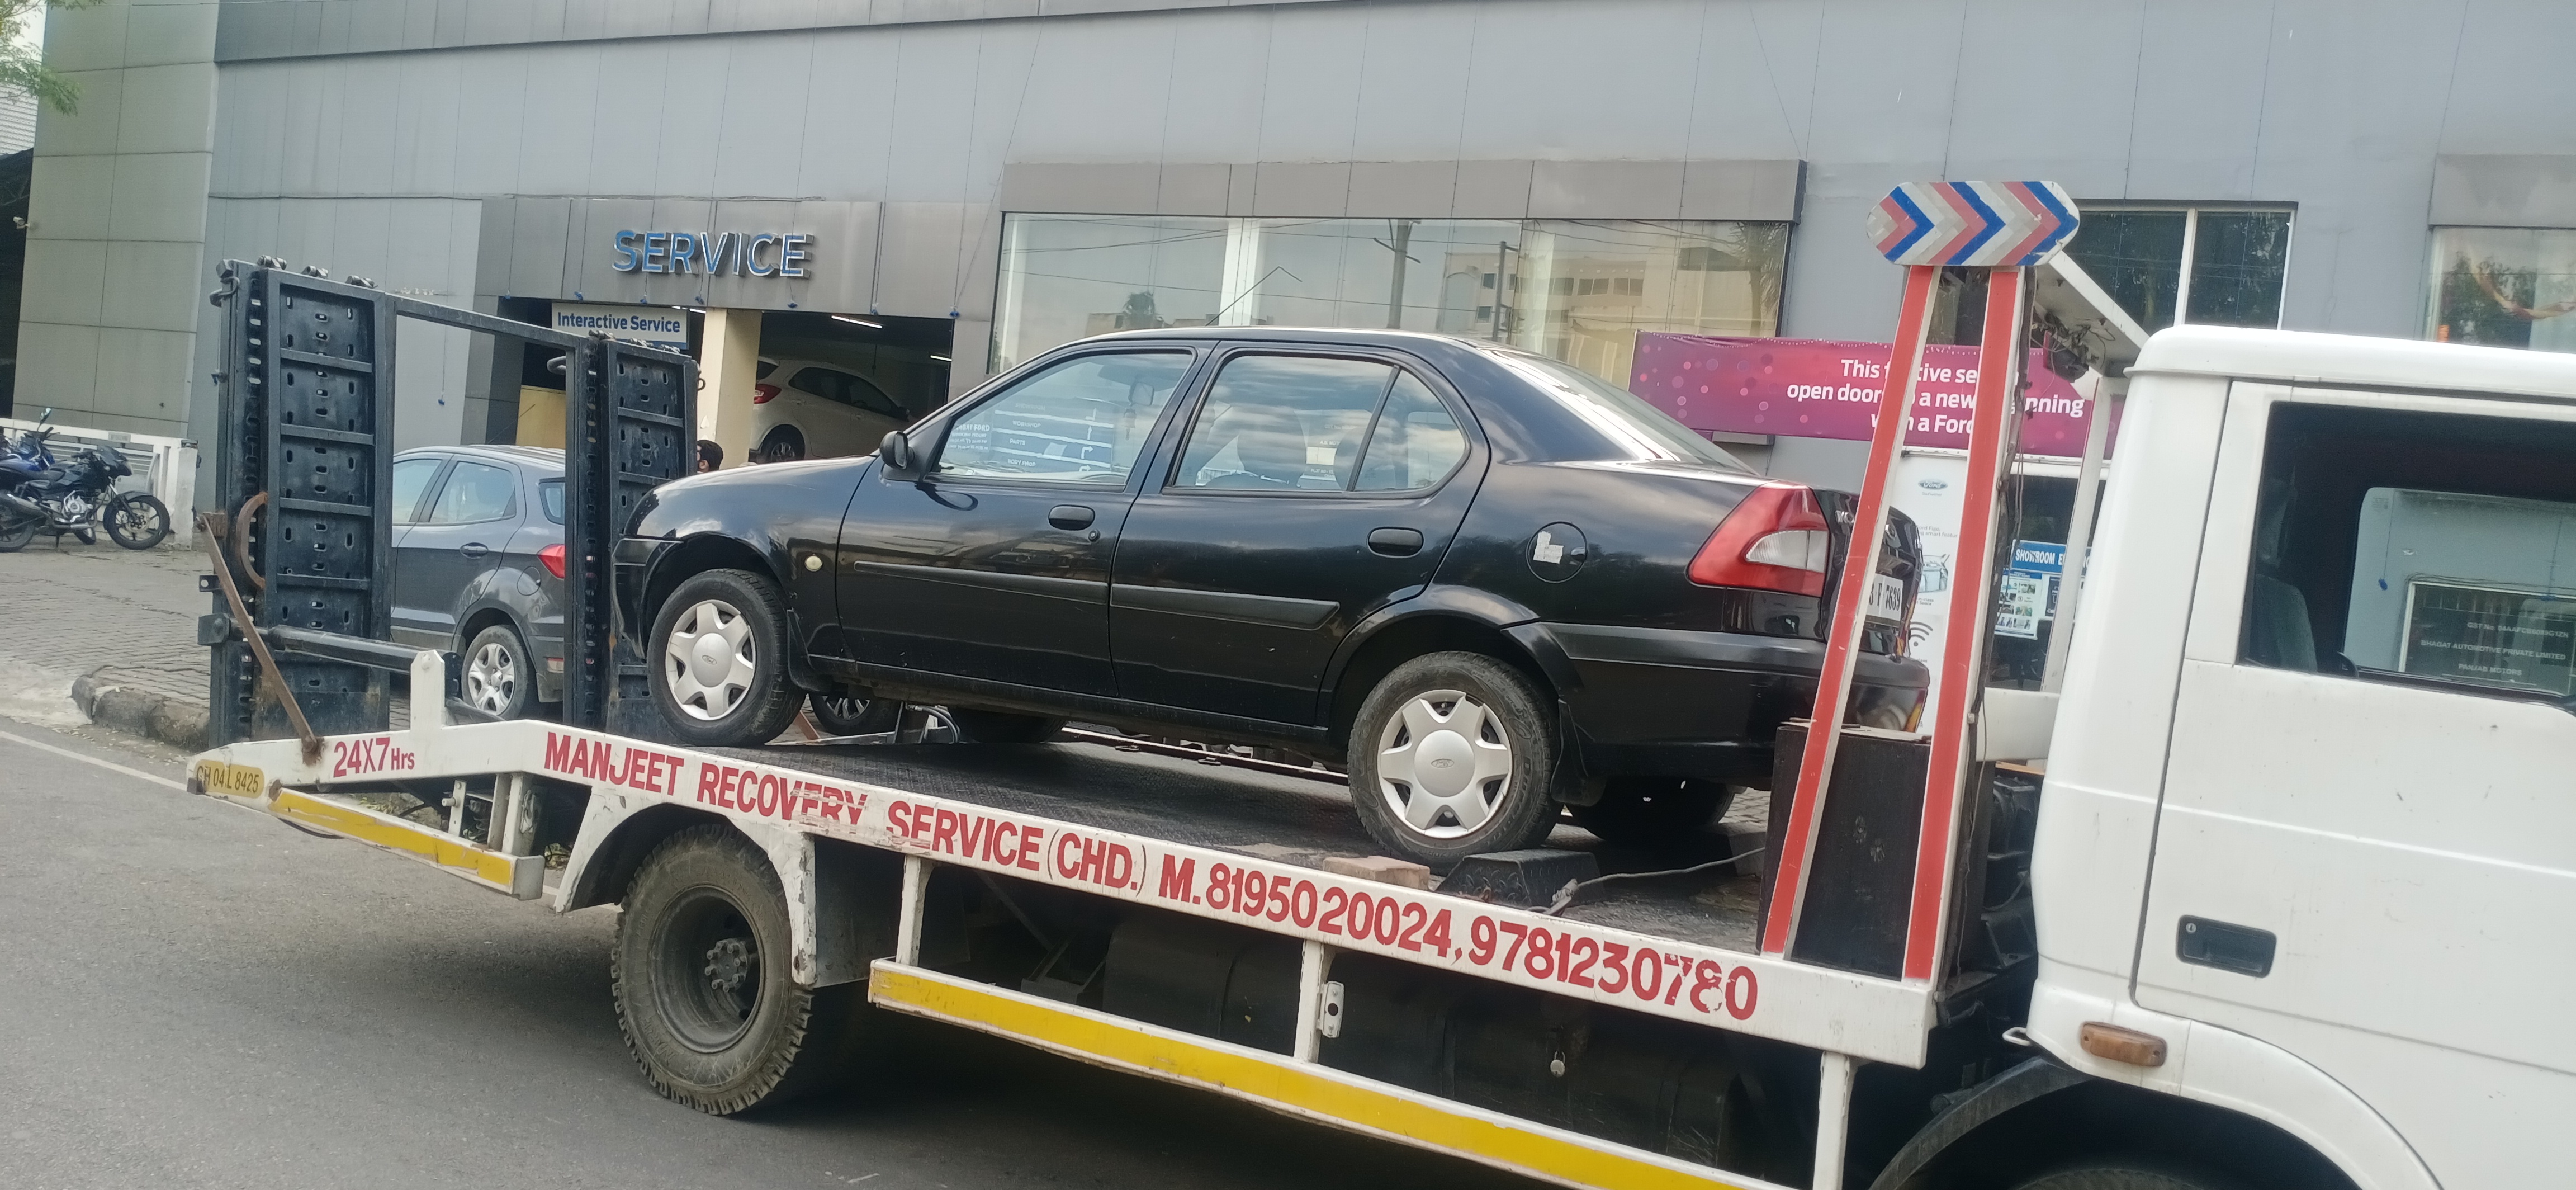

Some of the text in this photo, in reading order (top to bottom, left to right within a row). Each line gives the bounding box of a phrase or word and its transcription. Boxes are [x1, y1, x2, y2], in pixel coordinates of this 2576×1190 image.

[612, 230, 809, 278] SERVICE
[557, 311, 680, 333] Interactive Service
[1841, 358, 1881, 379] This
[1787, 384, 1834, 402] open
[1837, 382, 1883, 403] door
[1919, 391, 1931, 407] a
[1935, 393, 1977, 409] new
[2011, 394, 2085, 418] nning
[1917, 416, 1930, 432] a
[1921, 480, 1944, 489] Ford
[2015, 549, 2056, 565] SHOWROOM
[1886, 584, 1901, 611] 7639
[2503, 648, 2534, 657] PRIVATE
[2535, 652, 2566, 660] LIMITED
[391, 747, 415, 771] Hrs
[235, 771, 259, 794] 8425
[544, 731, 684, 796] MANJEET
[697, 762, 868, 825] RECOVERY
[886, 800, 1044, 872] SERVICE
[1158, 853, 1201, 905] M.
